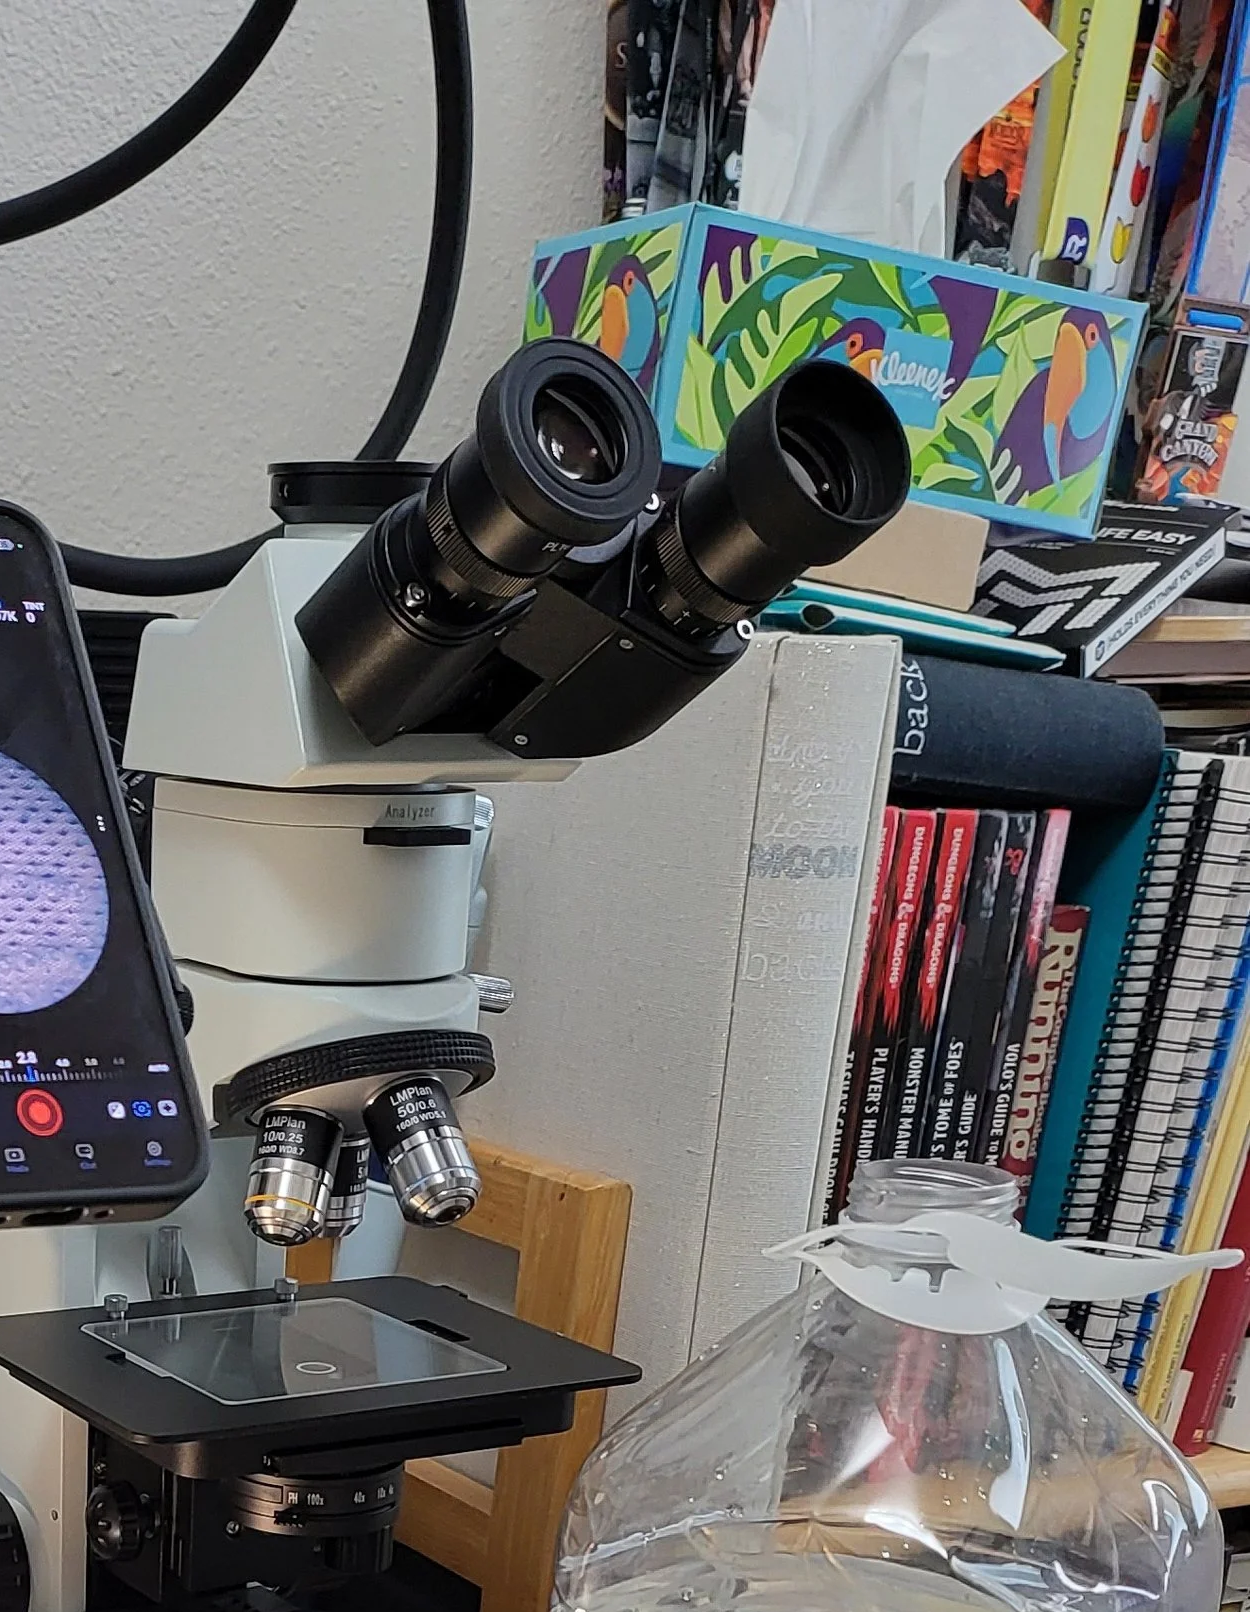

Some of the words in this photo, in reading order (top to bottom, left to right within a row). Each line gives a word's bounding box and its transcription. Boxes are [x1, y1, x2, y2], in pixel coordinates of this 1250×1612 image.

[871, 351, 956, 401] Kleenex
[1160, 439, 1219, 467] CANYON
[1176, 420, 1218, 442] GRAND
[1099, 527, 1132, 540] IFE
[1134, 530, 1196, 546] EASY
[385, 803, 436, 821] Analyzer
[904, 826, 926, 900] DUNGEONS
[941, 827, 964, 901] DUNGEONS
[889, 922, 908, 985] DRAGONS
[926, 922, 946, 985] DRAGONS
[1003, 927, 1083, 1162] Running
[865, 1047, 889, 1114] PLAYER'S
[901, 1047, 926, 1114] MONSTER
[934, 1098, 954, 1140] TOME
[945, 1039, 964, 1079] FOES
[1000, 1043, 1021, 1093] VOLO'S
[389, 1085, 434, 1106] LMPlan
[397, 1098, 438, 1118] 50/0.6
[958, 1092, 978, 1135] GUIDE
[990, 1093, 1010, 1137] GUIDE
[262, 1130, 305, 1144] 10/0.25
[265, 1115, 306, 1130] LMPlan
[893, 1117, 914, 1159] MANU
